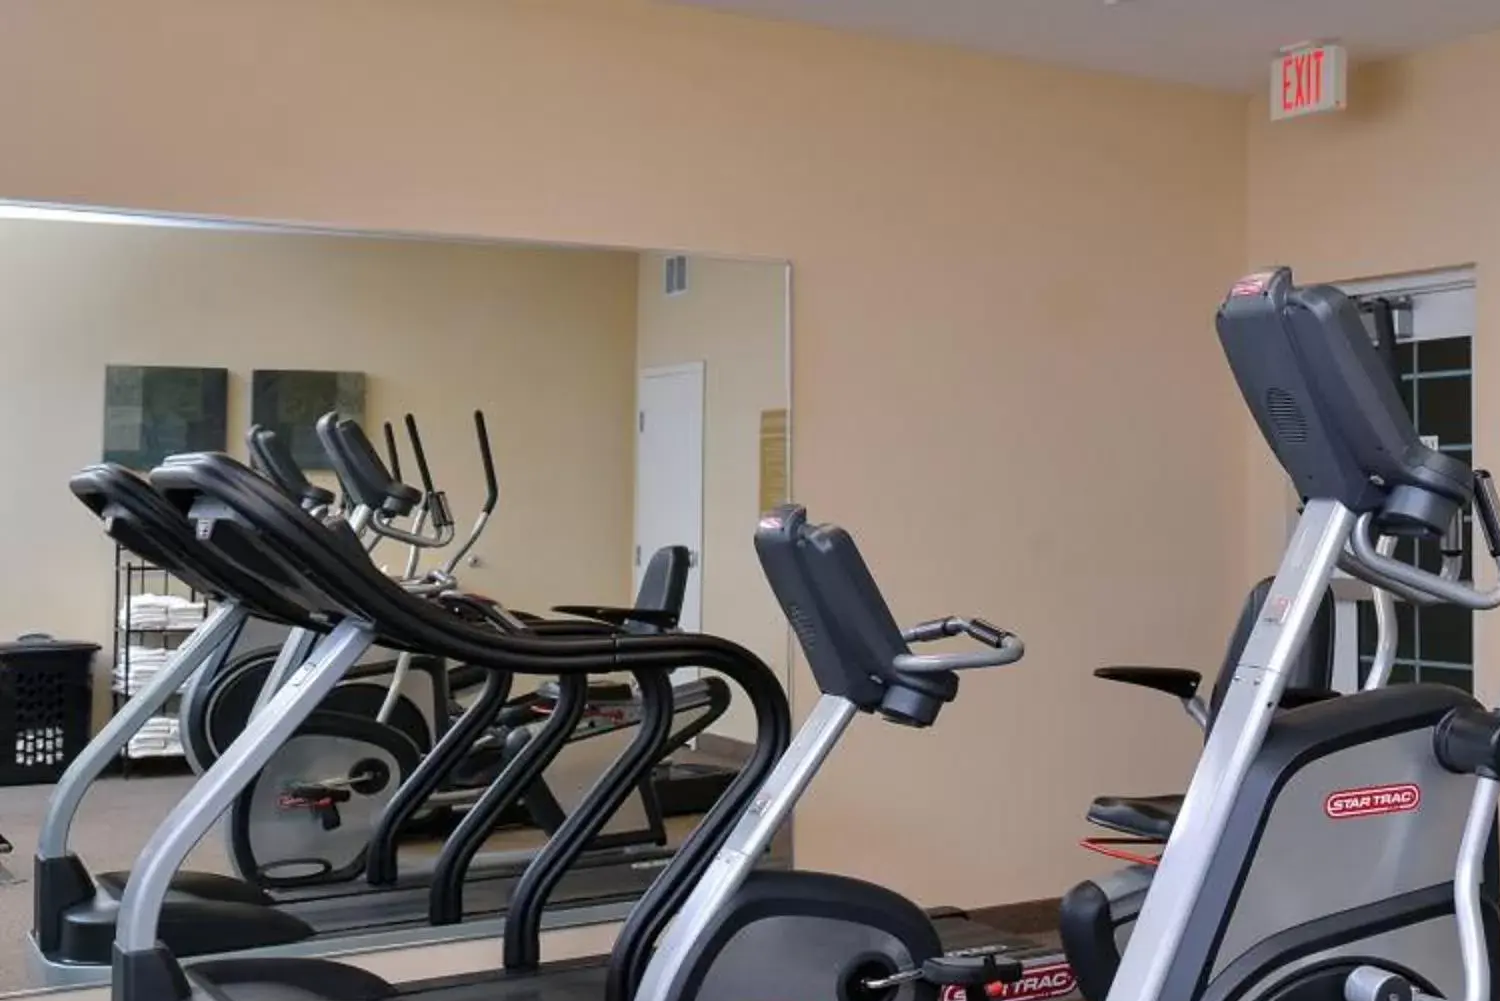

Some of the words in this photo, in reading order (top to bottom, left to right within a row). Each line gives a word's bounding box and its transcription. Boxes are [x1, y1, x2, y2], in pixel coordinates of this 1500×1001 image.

[1283, 50, 1324, 111] EXIT
[1332, 796, 1371, 811] STAR
[1372, 790, 1413, 806] TRAC
[1014, 971, 1068, 994] TRAC
